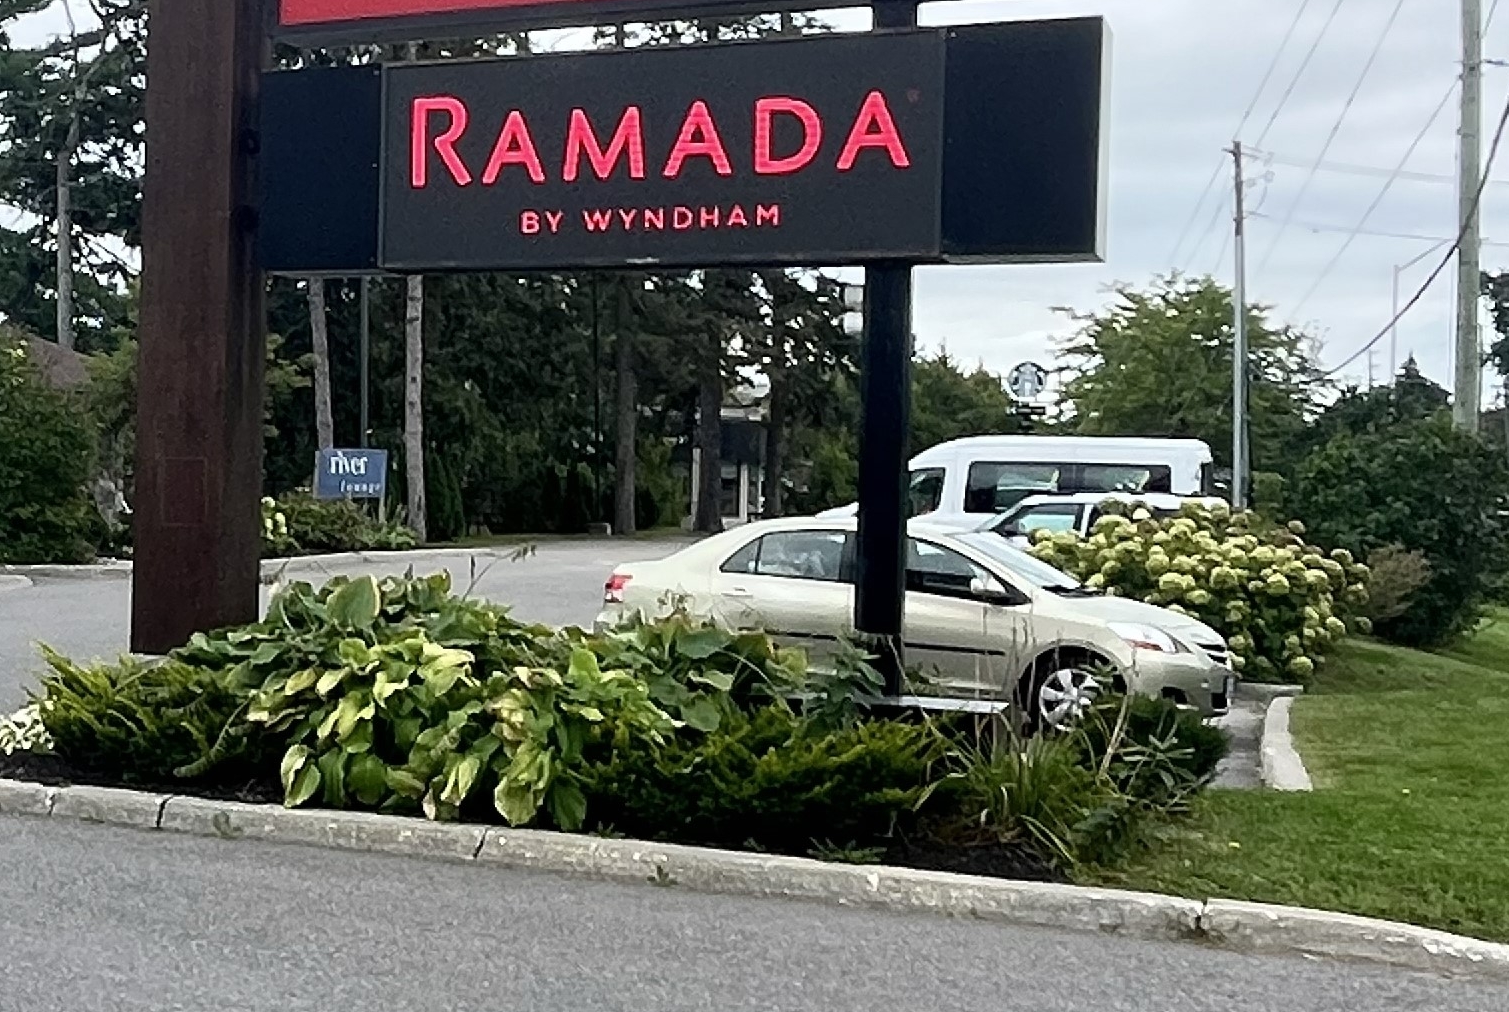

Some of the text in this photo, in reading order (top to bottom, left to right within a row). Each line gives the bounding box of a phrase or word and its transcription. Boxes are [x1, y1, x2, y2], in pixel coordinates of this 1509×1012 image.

[411, 90, 910, 187] RAMADA
[520, 204, 780, 234] BY WYNDHAM
